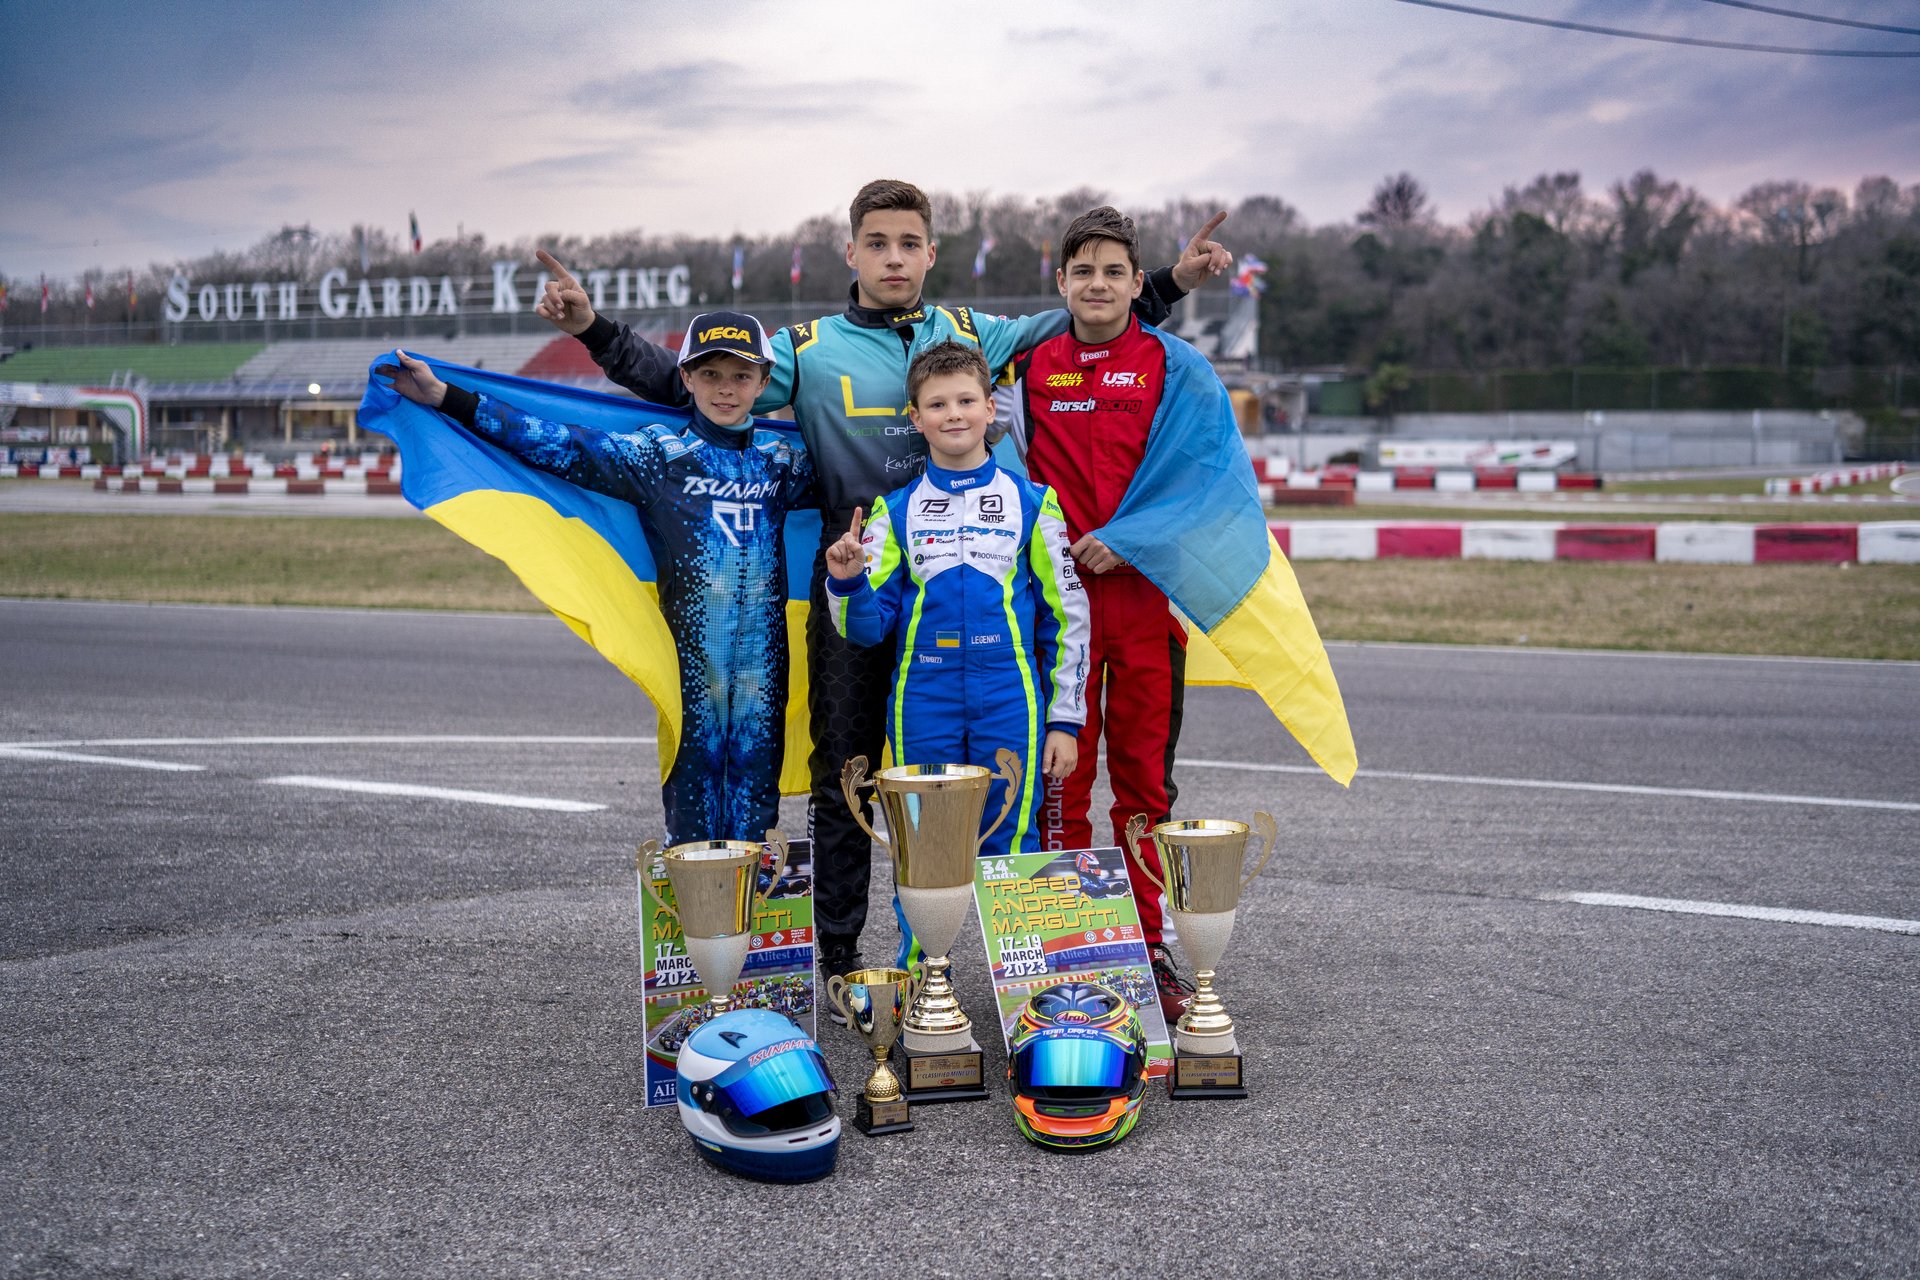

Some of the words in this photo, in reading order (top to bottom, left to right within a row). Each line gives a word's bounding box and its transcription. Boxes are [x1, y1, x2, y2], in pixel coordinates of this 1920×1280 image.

[165, 275, 298, 322] SOUTH
[318, 267, 457, 318] GARDA
[698, 326, 752, 344] VEGA
[1080, 350, 1109, 362] freem
[683, 476, 781, 499] TSUNAMI
[950, 478, 976, 489] freem
[911, 529, 955, 539] TEAM
[957, 526, 1016, 541] DRIVER
[919, 654, 943, 664] freem
[984, 876, 1082, 897] TROFEO
[992, 892, 1095, 916] ANDREA
[992, 908, 1120, 935] MARGUTTI
[997, 934, 1043, 951] 17-19
[657, 957, 692, 971] MARC
[757, 949, 790, 962] Alitest
[1001, 949, 1043, 963] MARCH
[1003, 961, 1049, 978] 2023
[1068, 1028, 1099, 1037] DRIVER
[748, 1040, 804, 1067] TSUNAMI
